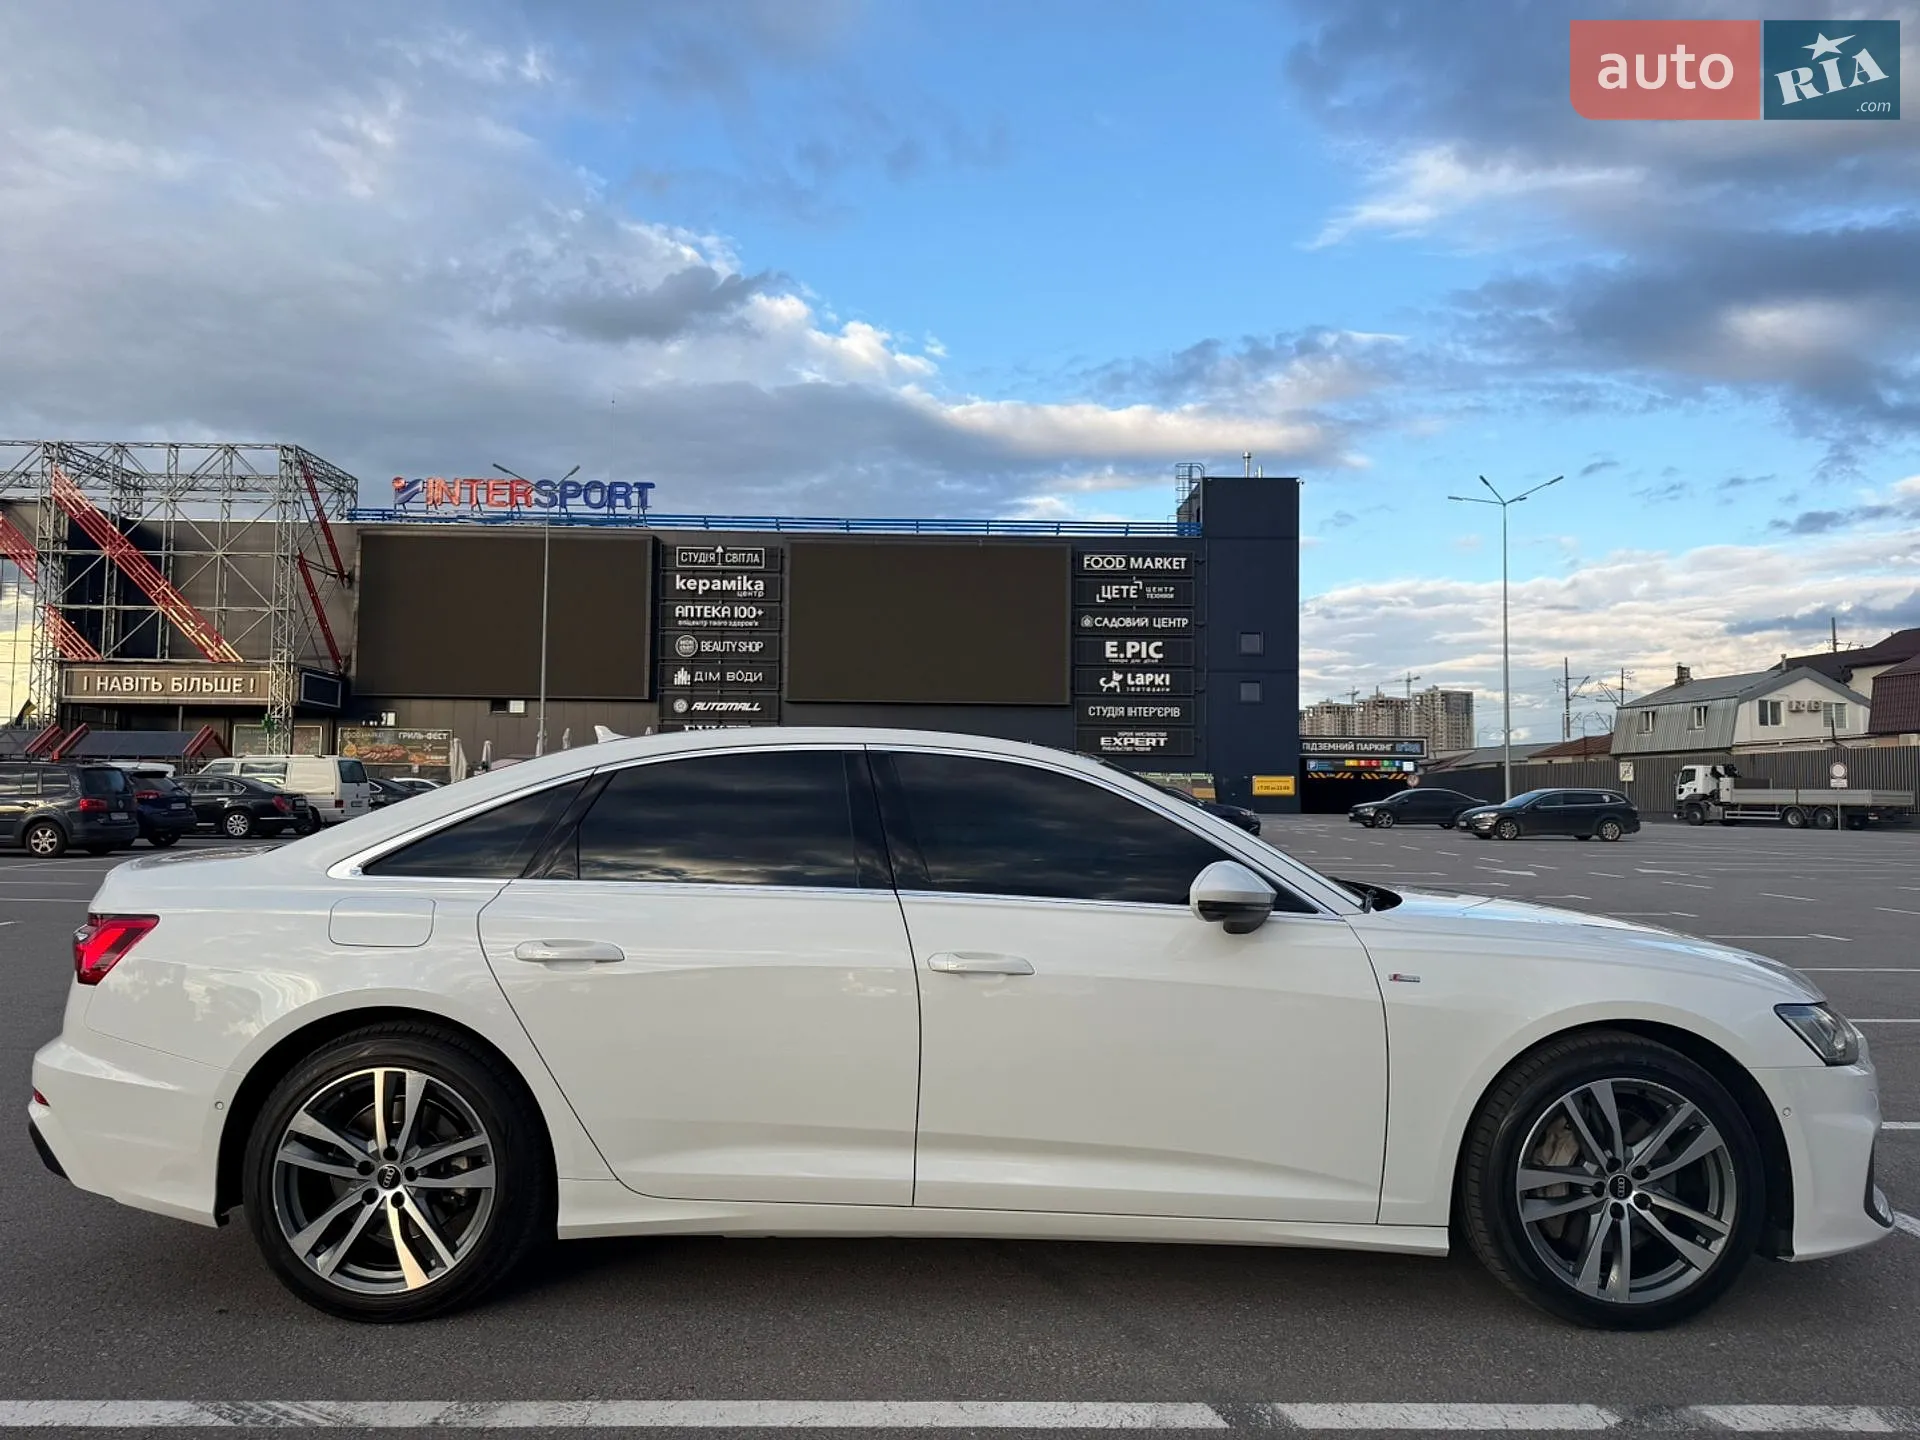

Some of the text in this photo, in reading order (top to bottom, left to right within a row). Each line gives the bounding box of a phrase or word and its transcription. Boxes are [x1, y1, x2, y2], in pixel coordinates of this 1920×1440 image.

[425, 478, 656, 510] INTERSPORT
[681, 552, 760, 563] СТУДІЯ СВІТЛА
[1083, 555, 1187, 570] FOOD MARKET
[1101, 585, 1138, 600] ЦЕТЕ
[675, 605, 764, 618] АПТЕКА 100+
[1094, 617, 1189, 629] САДОВИЙ ЦЕНТР
[701, 641, 737, 652] BEAUTY
[738, 641, 764, 652] SHOP
[1105, 641, 1164, 659] E.PIC
[694, 669, 763, 682] ДІМ ВОДИ
[96, 676, 164, 692] НАВІТЬ
[171, 677, 244, 693] БІЛЬШЕ
[691, 702, 762, 711] AUTOMALL
[1088, 706, 1125, 718] СТУДІЯ
[1100, 736, 1169, 747] EXPERT
[1302, 741, 1355, 752] ПІДЗЕМНИЙ
[1356, 743, 1393, 751] ПАРКІНГ
